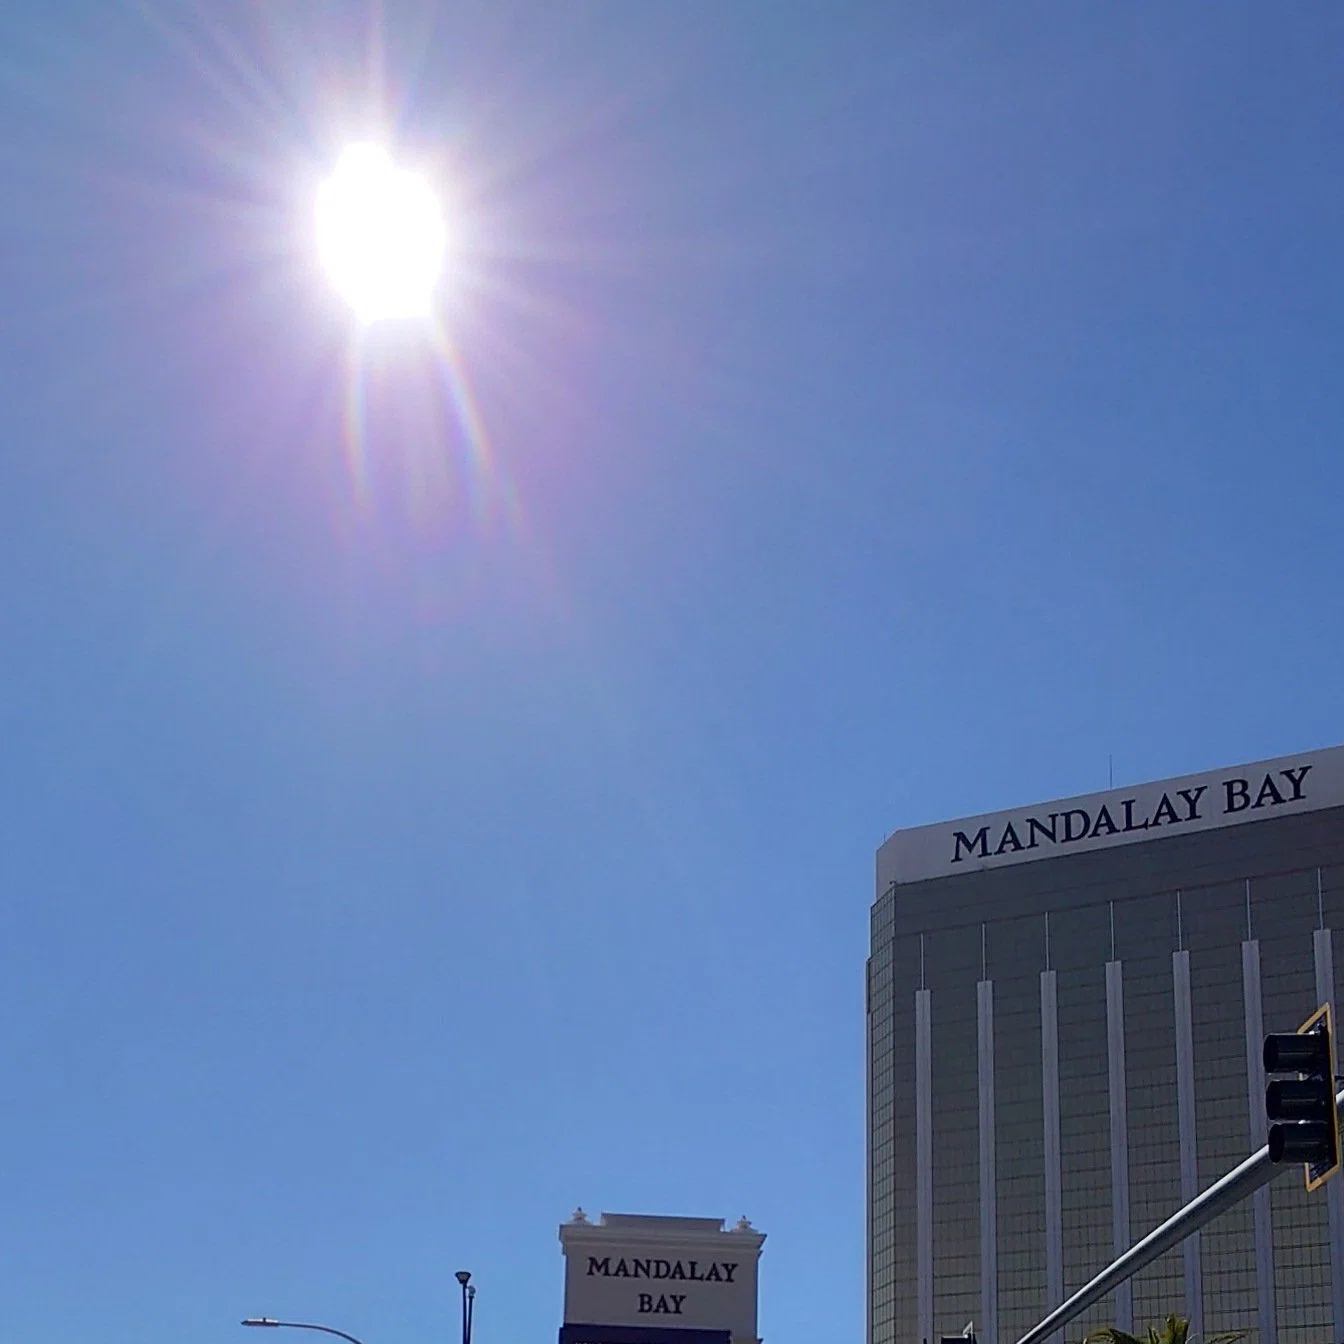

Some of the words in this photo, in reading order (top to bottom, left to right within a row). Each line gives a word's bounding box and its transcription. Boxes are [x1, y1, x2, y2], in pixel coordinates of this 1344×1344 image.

[951, 786, 1208, 864] MANDALAY
[1222, 765, 1313, 815] BAY
[586, 1257, 739, 1283] MANDALAY
[637, 1294, 687, 1314] BAY
